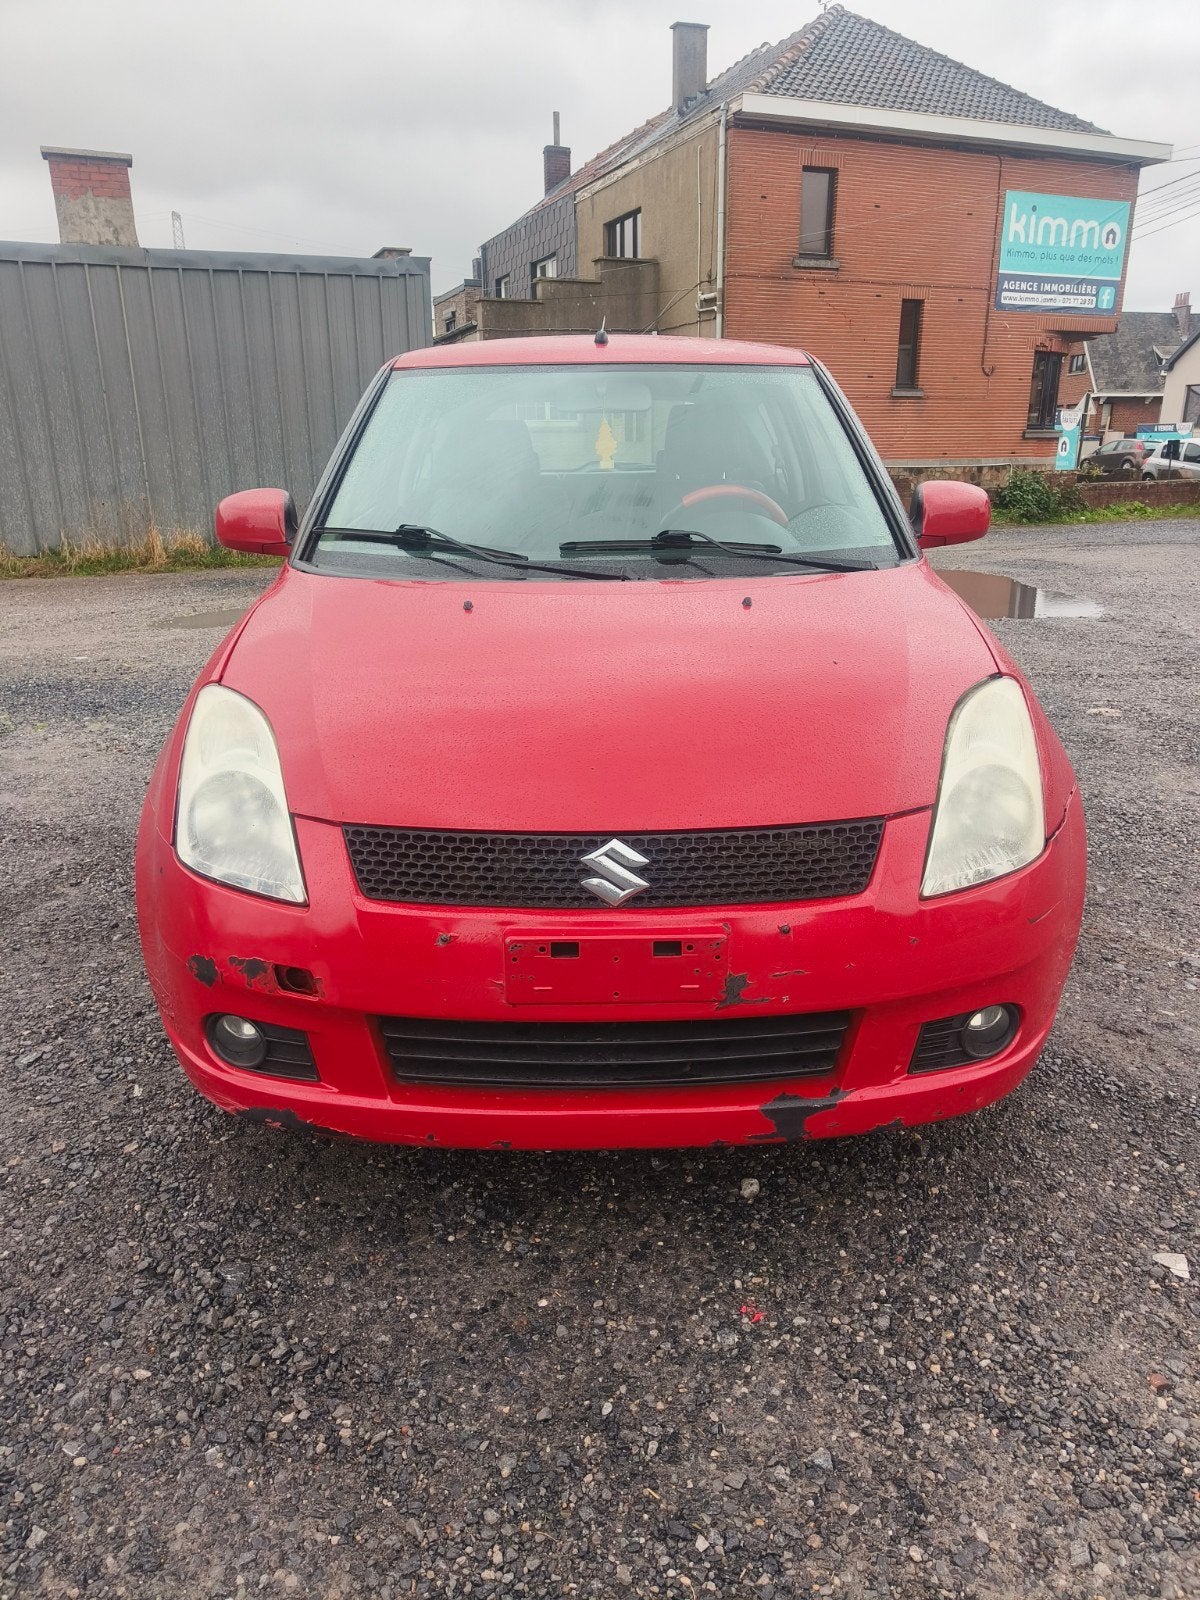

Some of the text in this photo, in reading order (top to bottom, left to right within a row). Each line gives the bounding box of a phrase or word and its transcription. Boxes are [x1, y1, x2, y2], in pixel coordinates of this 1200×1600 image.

[1008, 202, 1121, 250] kimmo
[1040, 251, 1057, 262] plus
[1060, 253, 1075, 263] que
[1078, 253, 1092, 263] des
[1094, 256, 1113, 265] mots
[1003, 281, 1097, 294] AGENCE IMMOBILIÈRE
